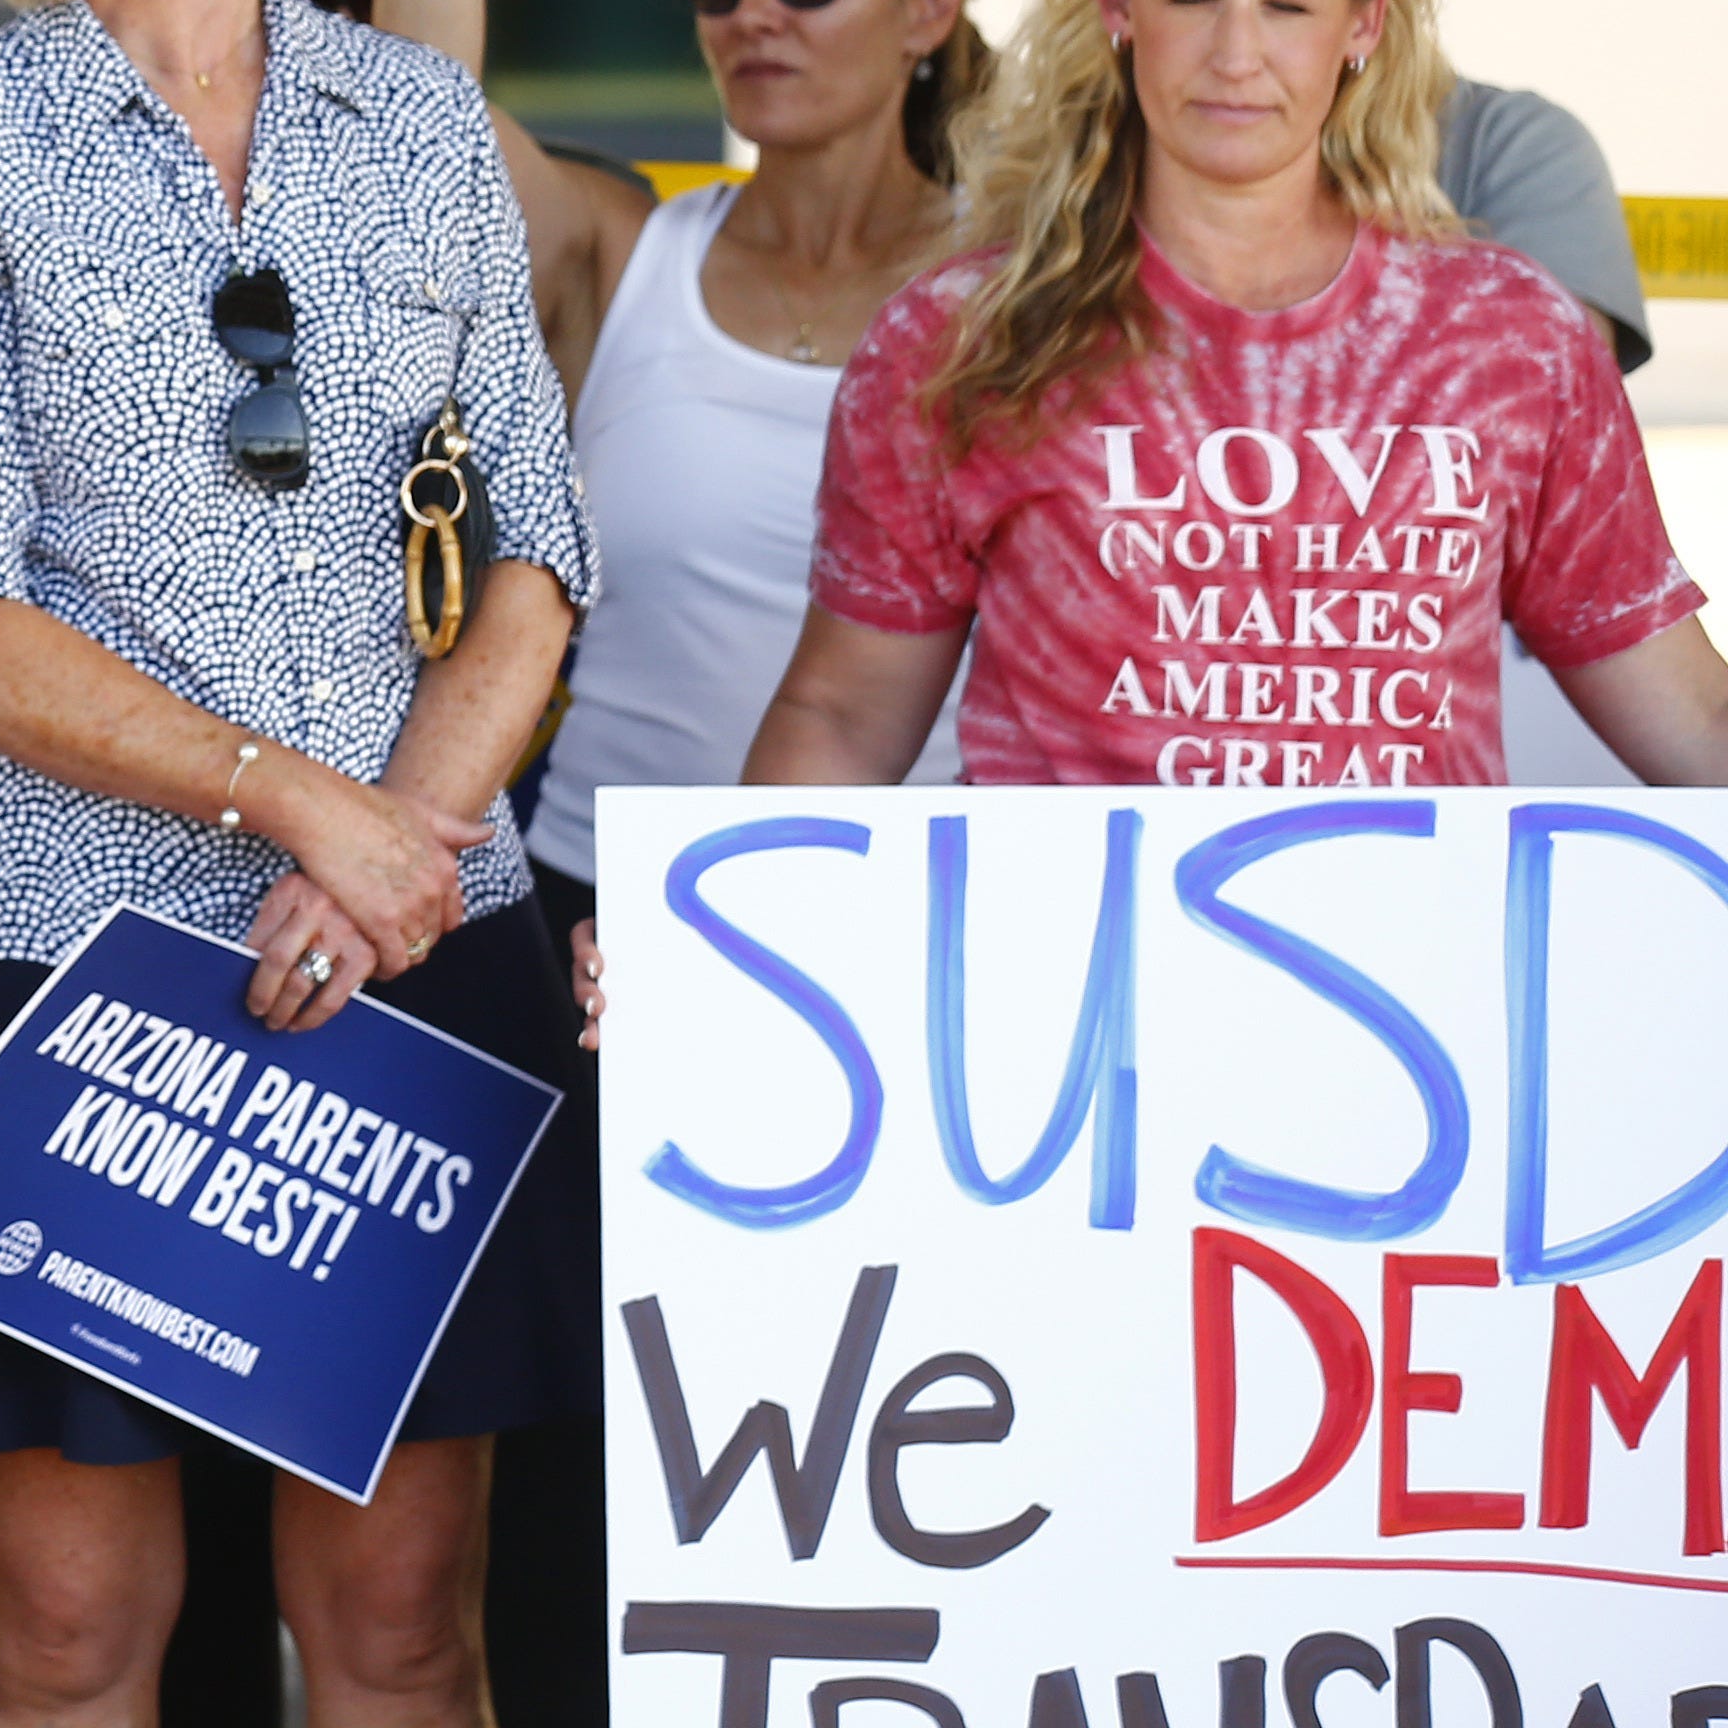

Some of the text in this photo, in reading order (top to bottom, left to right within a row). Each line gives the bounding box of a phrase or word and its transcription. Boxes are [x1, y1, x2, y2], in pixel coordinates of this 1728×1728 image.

[1091, 424, 1490, 522] LOVE
[1099, 519, 1482, 589] (NOT HATE)
[1150, 584, 1443, 654] MAKES
[1154, 735, 1424, 786] GREAT
[642, 800, 1728, 1285] SUSD
[36, 991, 474, 1234] ARIZONA PARENTS
[43, 1084, 362, 1283] KNOW BEST!
[37, 1250, 262, 1378] PARENTKNOWBEST.COM
[620, 1265, 1052, 1569] We
